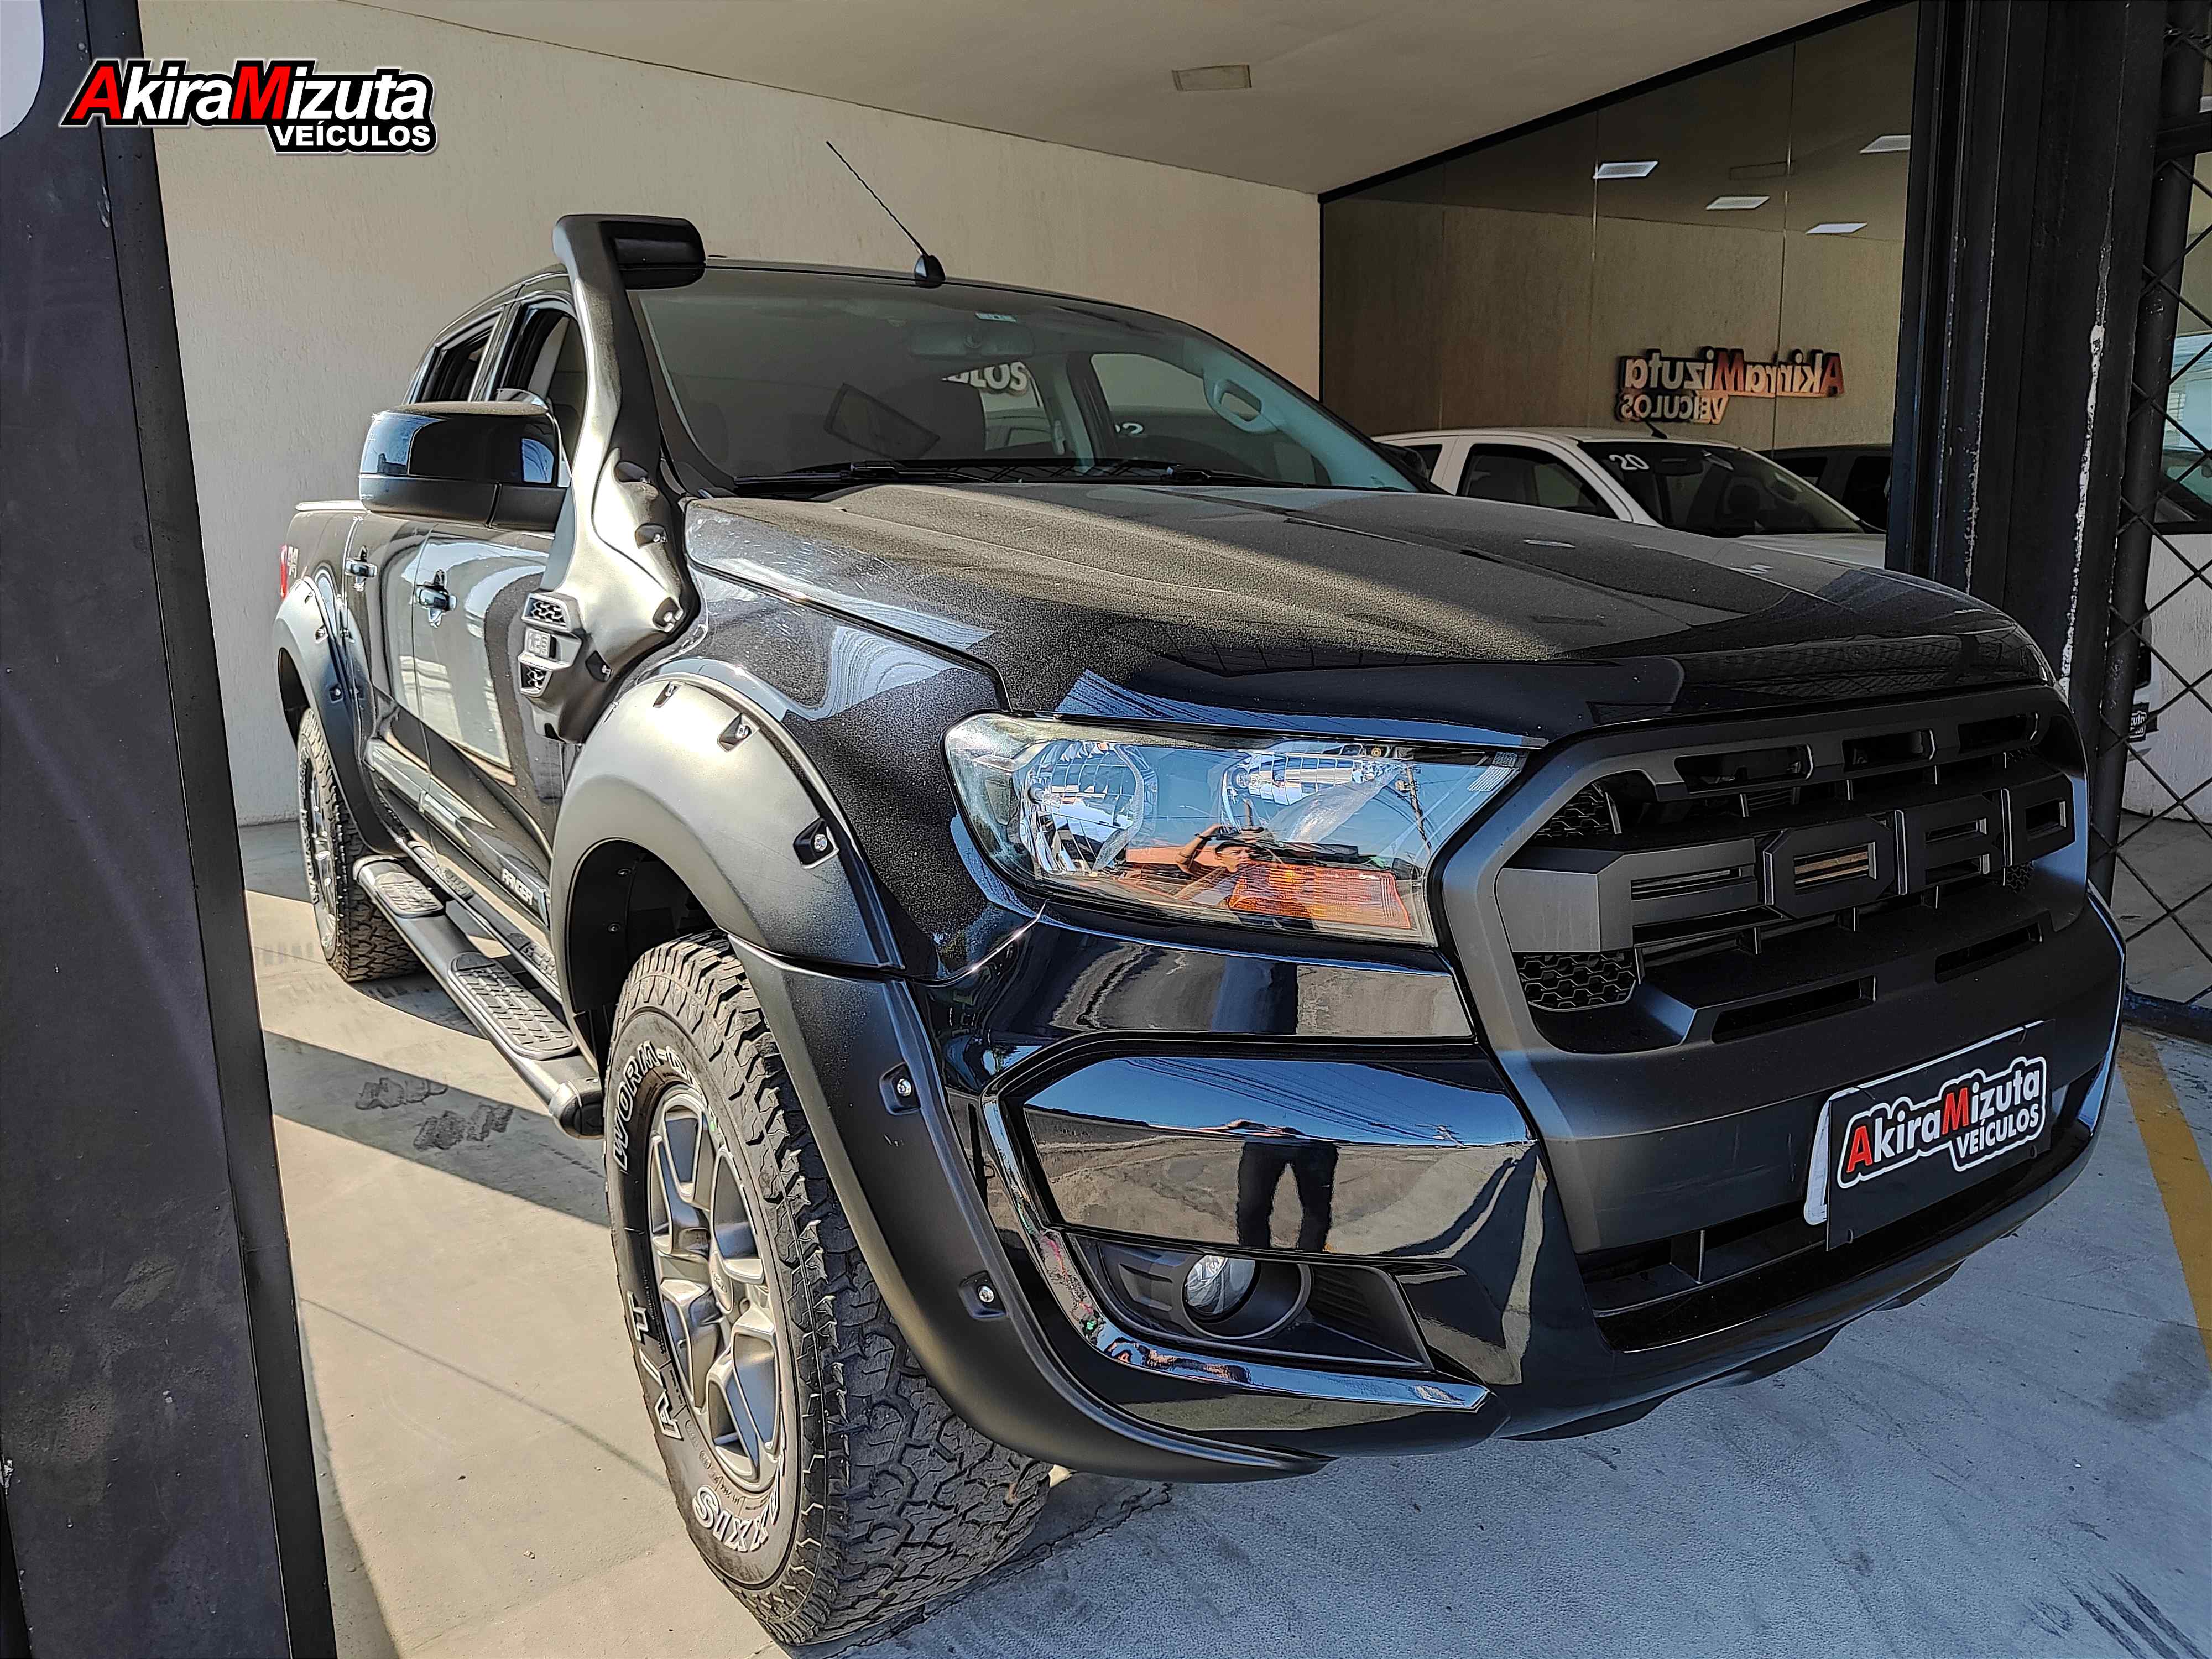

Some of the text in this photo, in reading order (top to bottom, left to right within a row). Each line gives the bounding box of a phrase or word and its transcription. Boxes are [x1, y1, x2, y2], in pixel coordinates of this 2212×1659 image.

[1609, 454, 1650, 471] 20
[500, 867, 534, 906] RANGER
[1595, 774, 2077, 952] FORD
[1846, 1068, 2041, 1173] AkiraMizuta
[1956, 1103, 2039, 1159] VEÍCULOS
